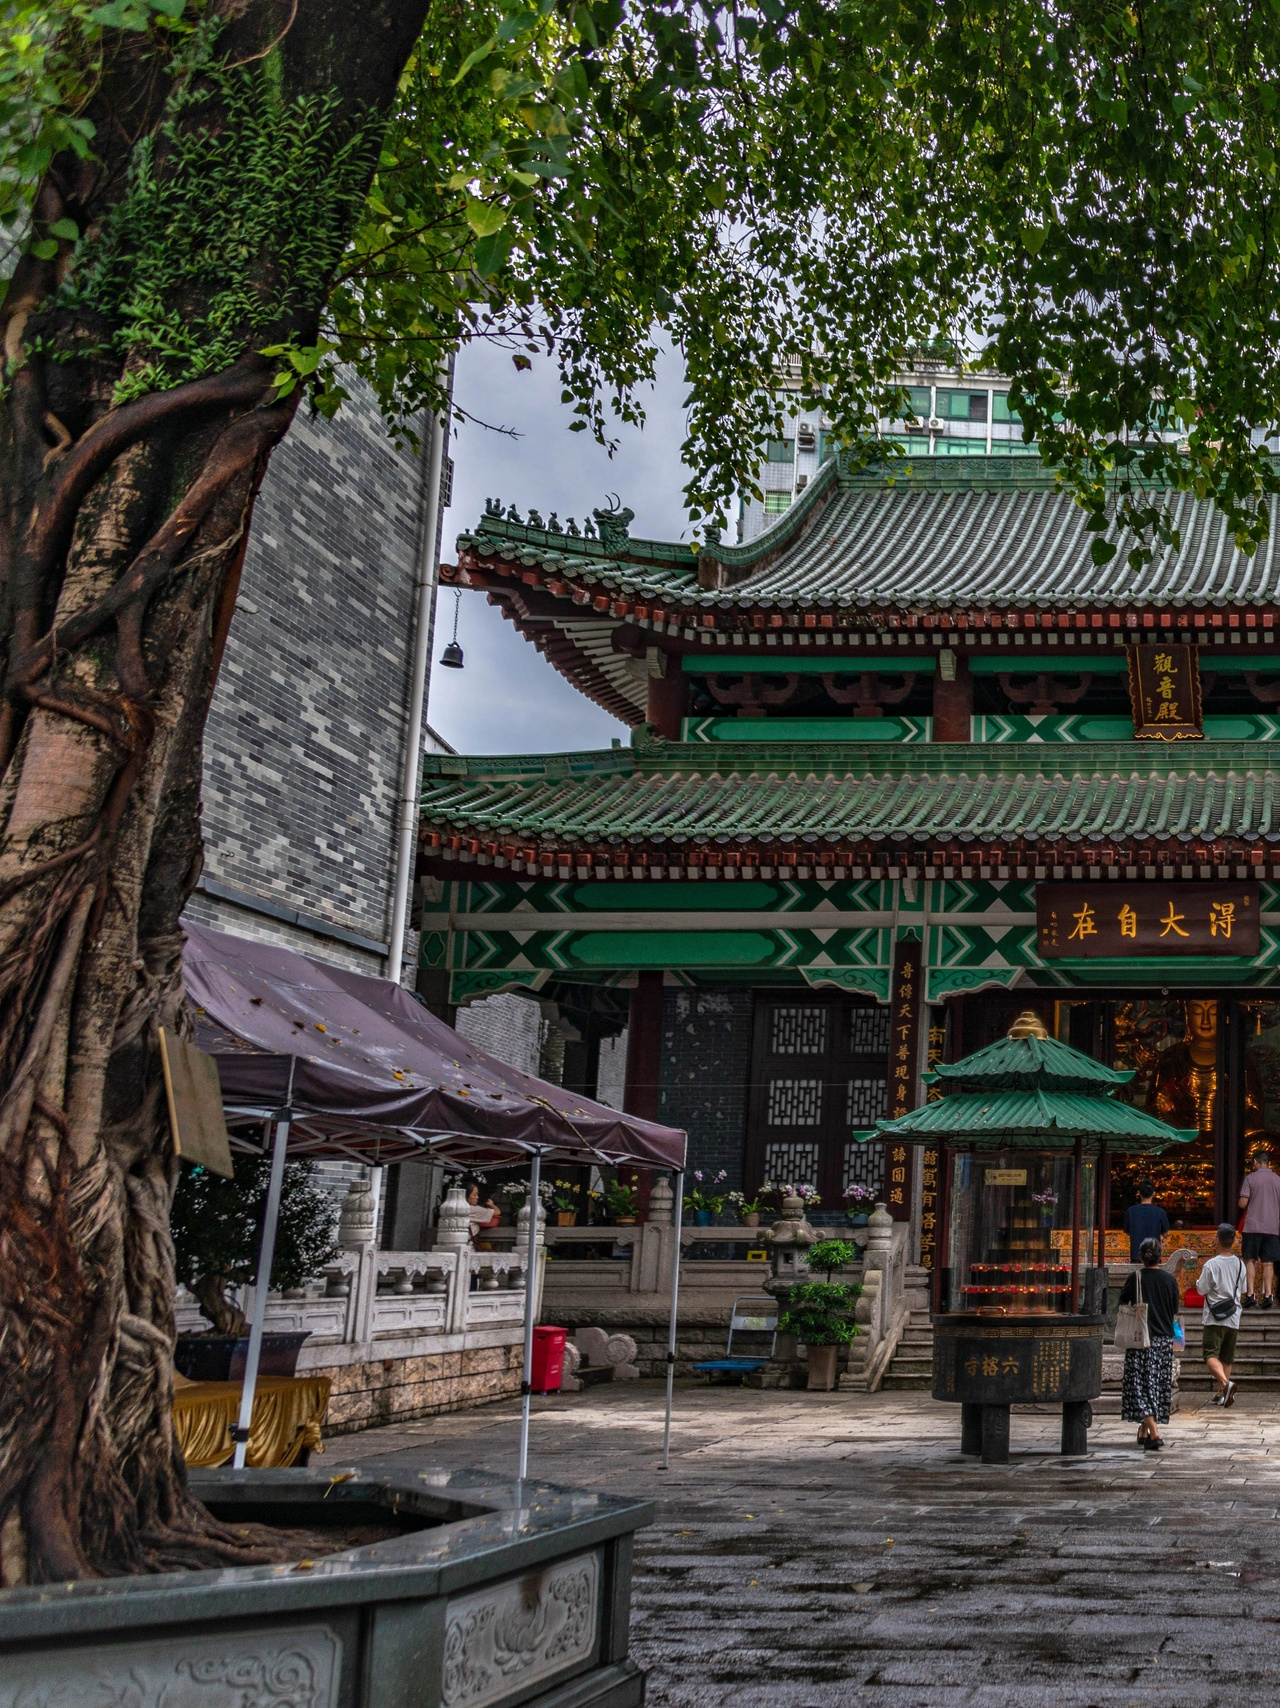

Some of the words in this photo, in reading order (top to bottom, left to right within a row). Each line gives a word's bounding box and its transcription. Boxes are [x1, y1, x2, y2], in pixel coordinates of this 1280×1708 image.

[1153, 652, 1183, 721] 觀音殿
[889, 961, 914, 1205] 音傳天下普現身證諦圓通
[964, 1356, 1019, 1376] 六榕寺
